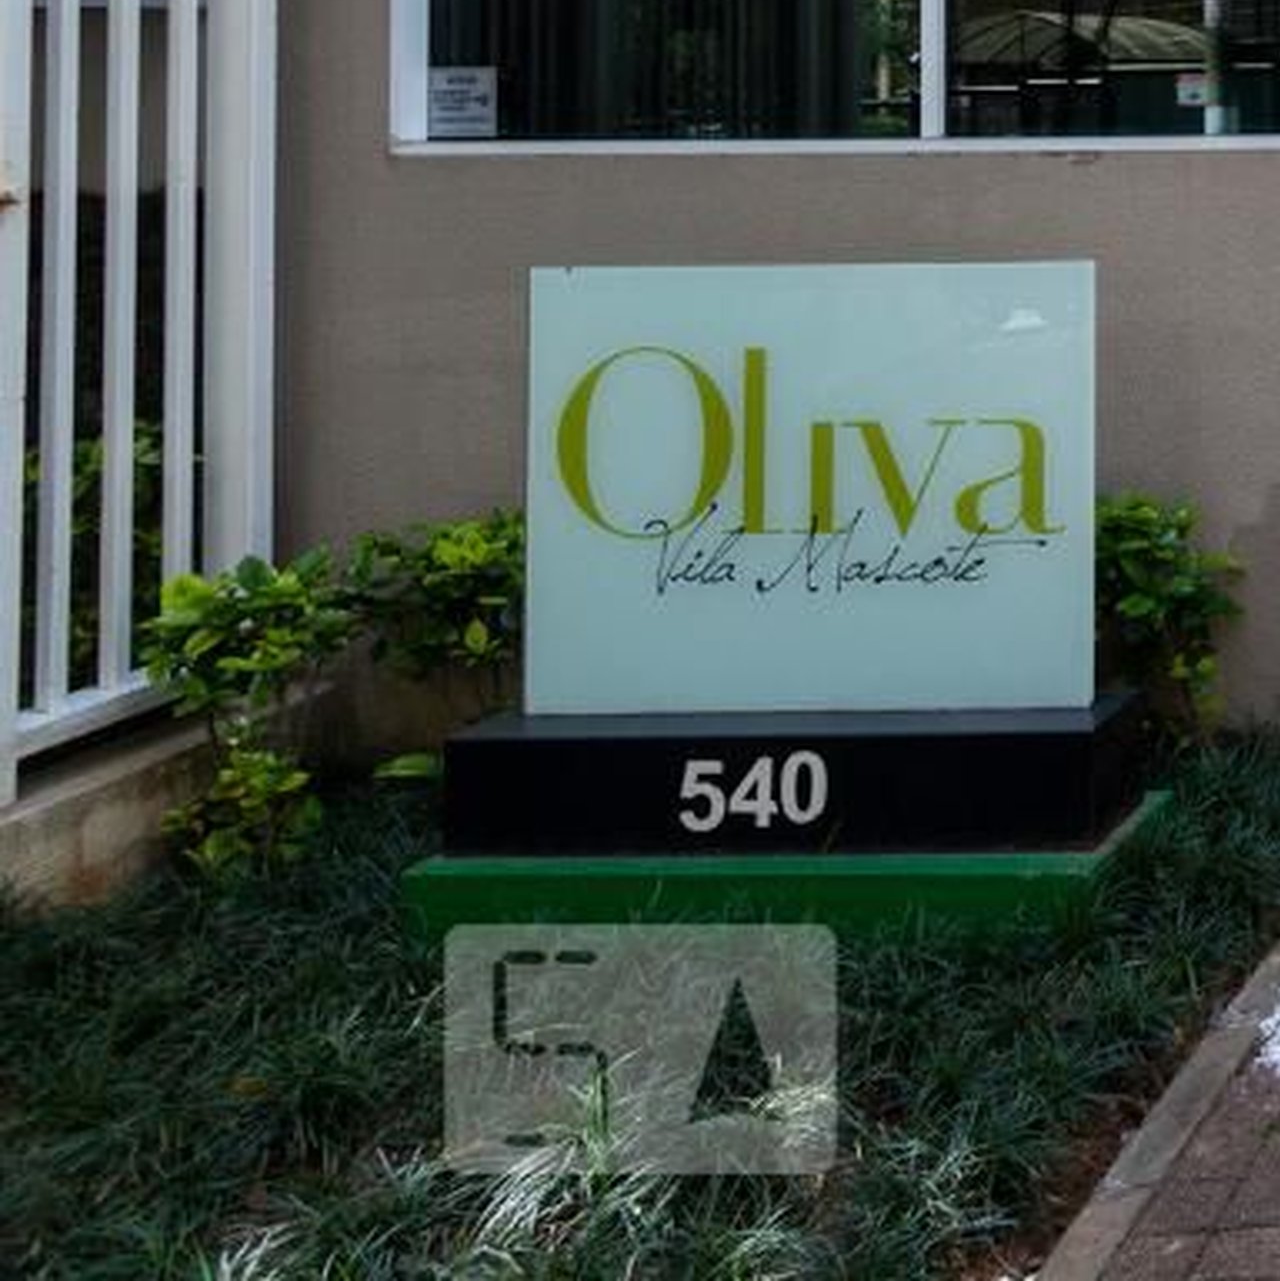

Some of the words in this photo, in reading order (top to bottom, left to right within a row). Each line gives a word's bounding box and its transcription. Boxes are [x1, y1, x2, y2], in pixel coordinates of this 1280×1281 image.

[556, 345, 1066, 540] Oliva
[644, 503, 746, 596] Vila
[678, 750, 829, 833] 540
